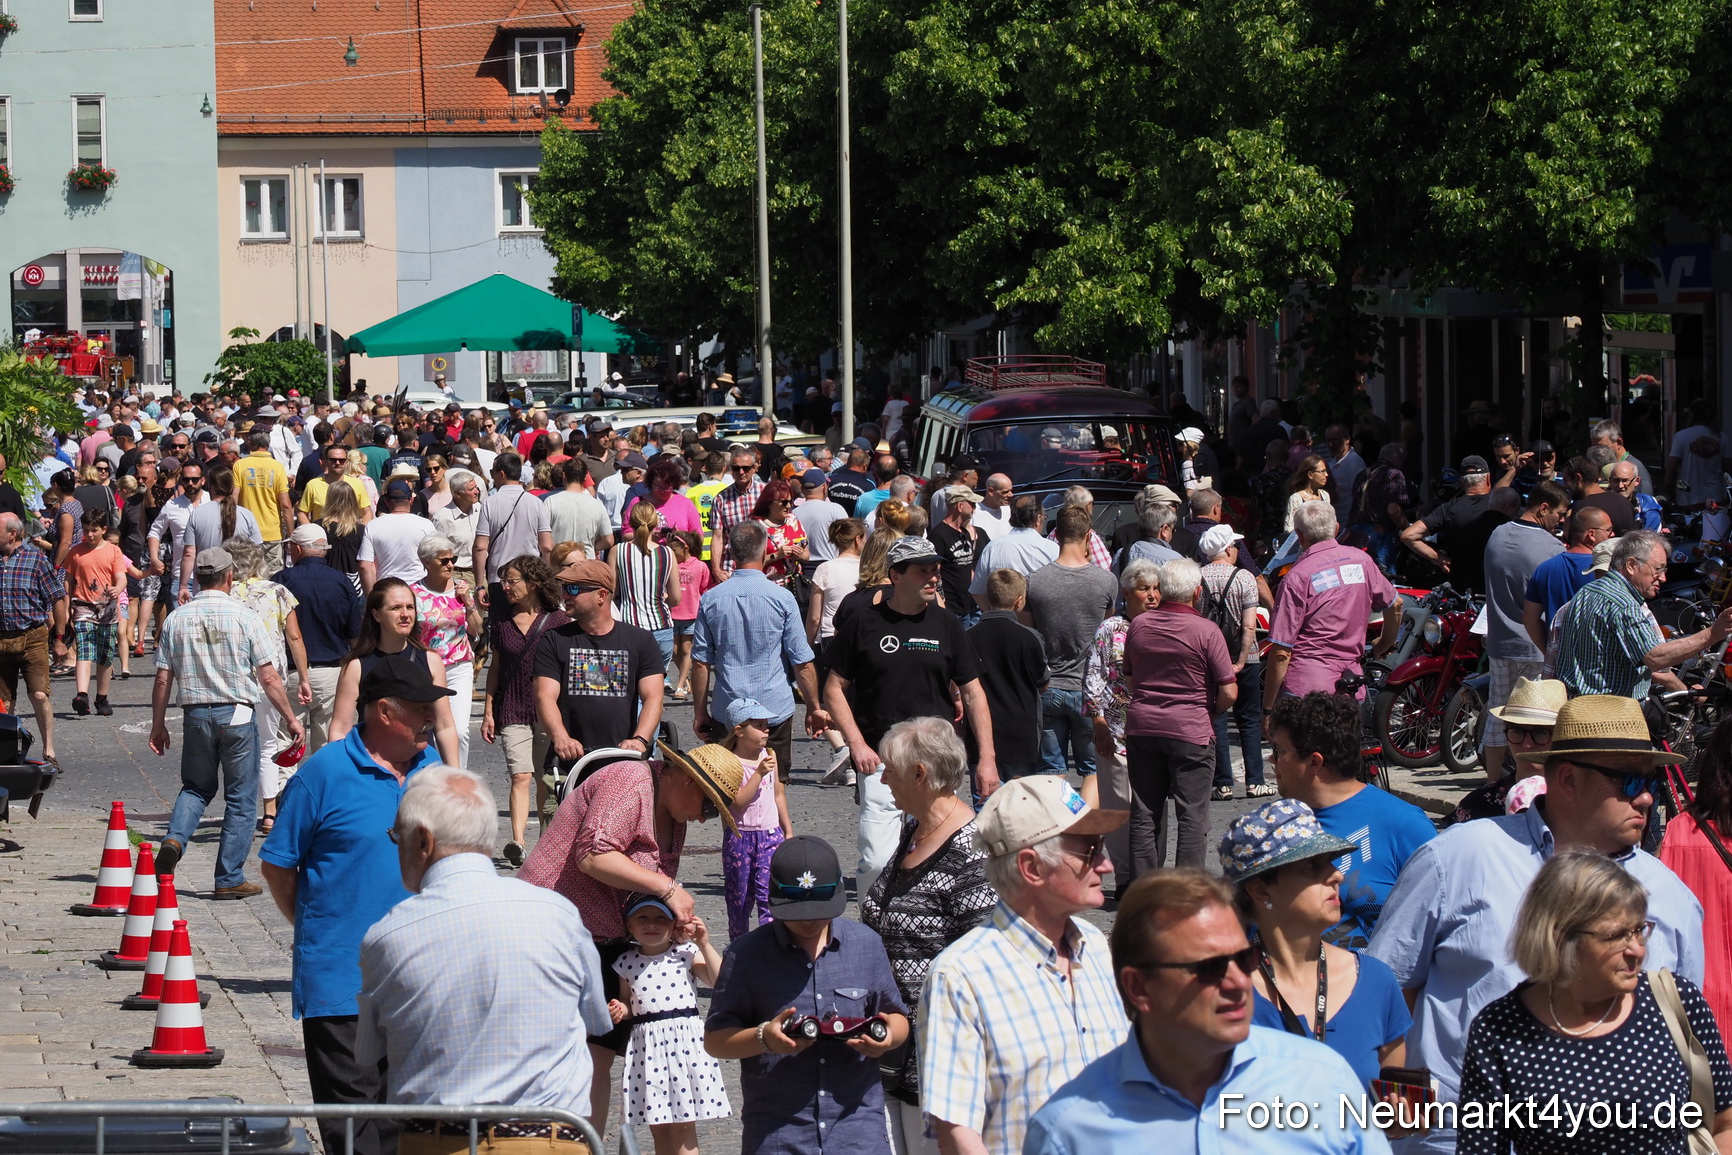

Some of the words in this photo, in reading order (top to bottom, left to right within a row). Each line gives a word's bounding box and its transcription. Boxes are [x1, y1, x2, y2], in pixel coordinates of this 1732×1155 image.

[85, 265, 119, 273] KIRSC
[573, 309, 580, 332] P
[830, 491, 858, 500] Seubersd
